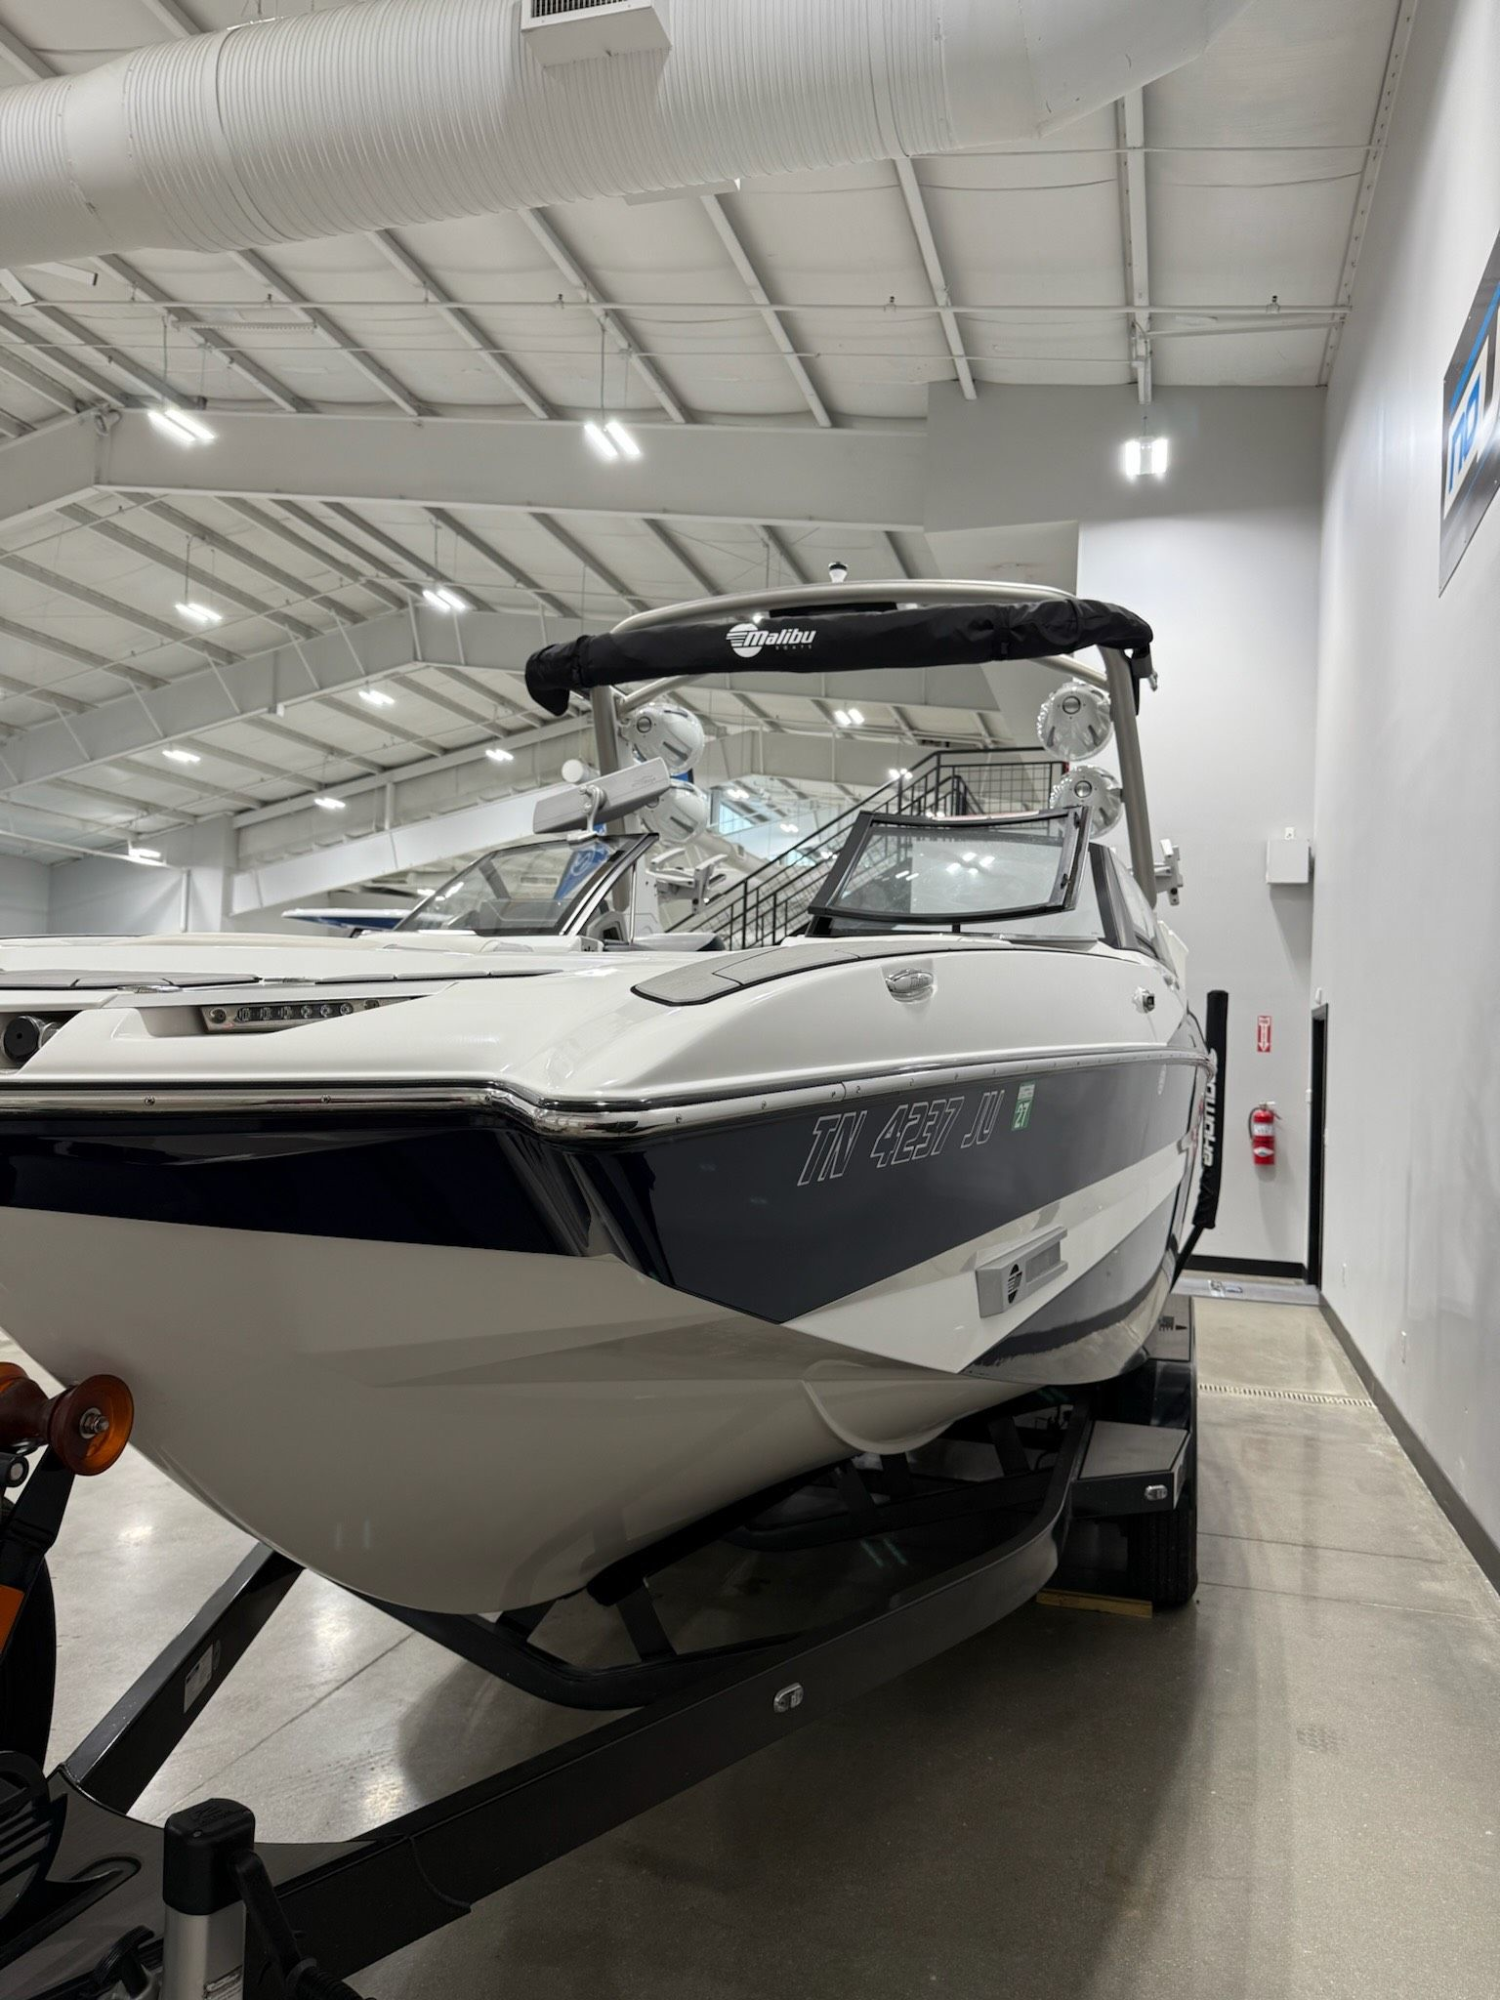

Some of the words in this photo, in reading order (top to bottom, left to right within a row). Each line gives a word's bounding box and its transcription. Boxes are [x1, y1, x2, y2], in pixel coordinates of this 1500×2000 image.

[743, 628, 816, 647] Malibu
[1014, 1102, 1030, 1129] 27
[797, 1110, 867, 1187] TN
[870, 1096, 965, 1168] 4237
[961, 1090, 1004, 1148] JU
